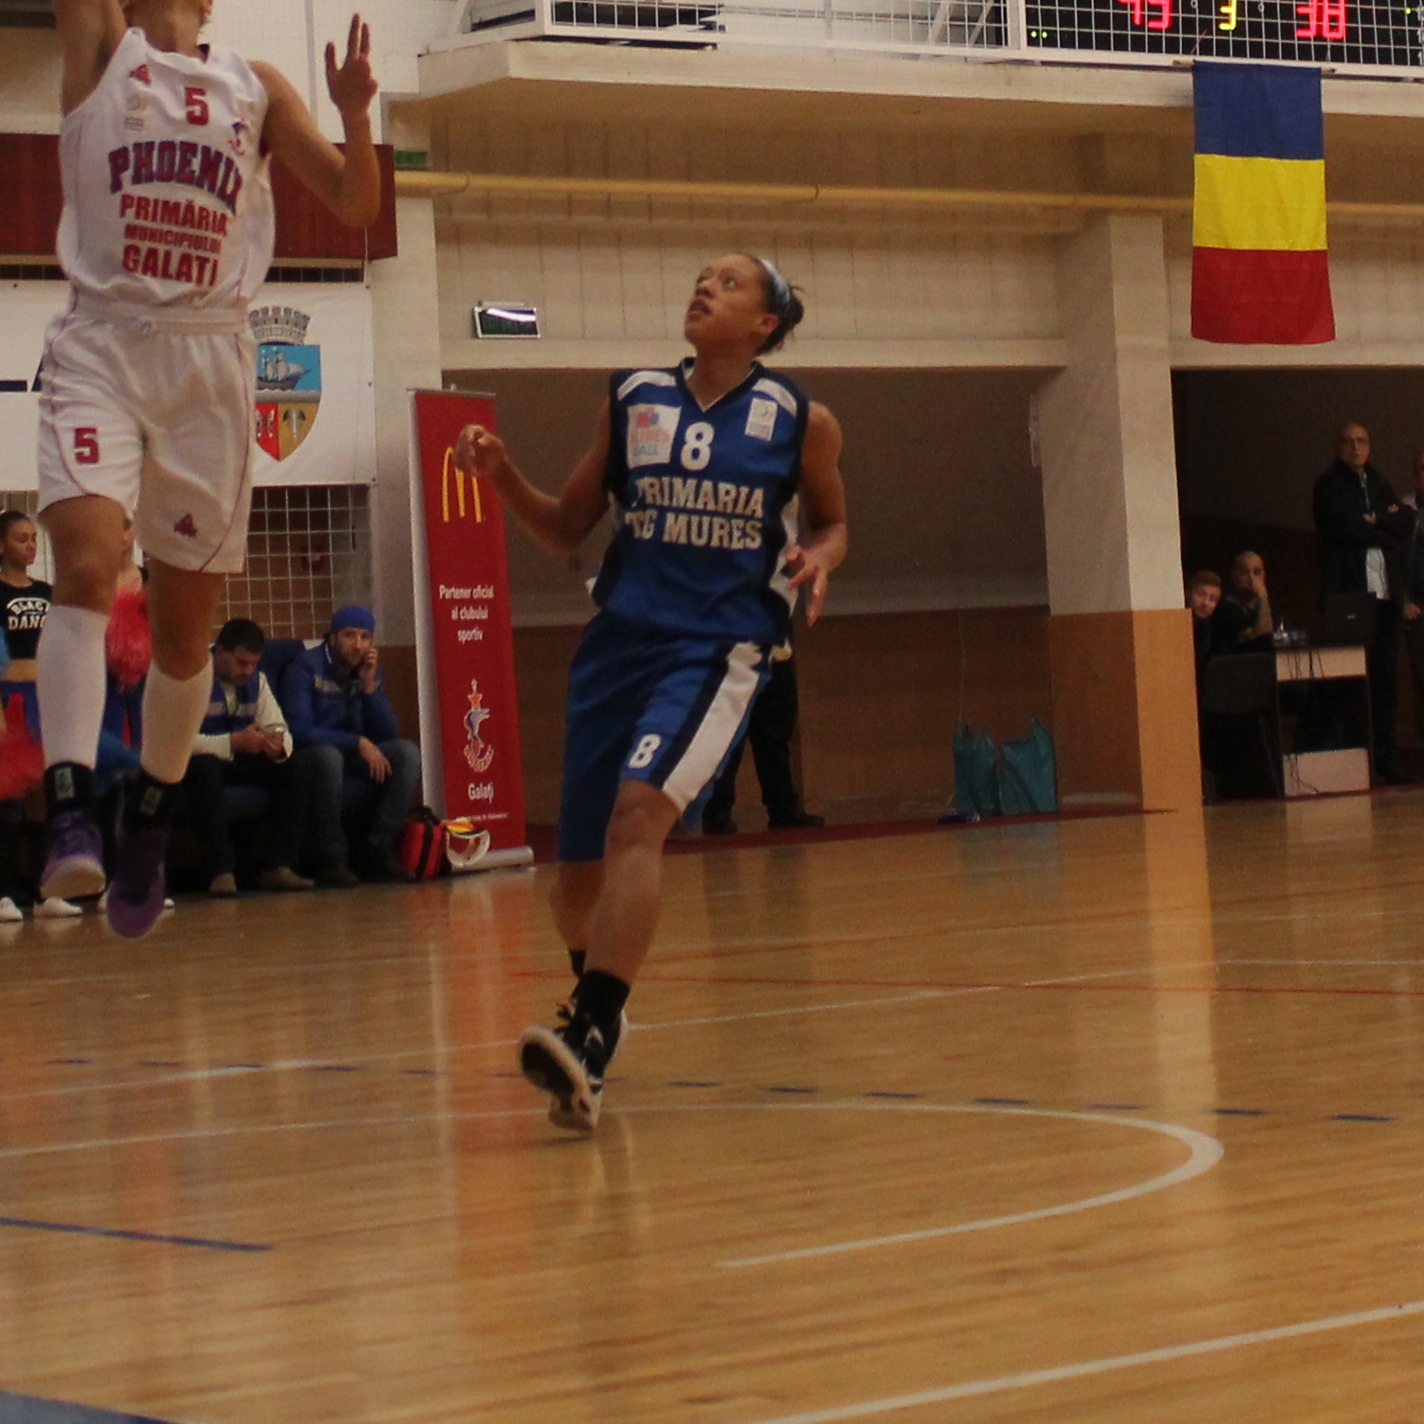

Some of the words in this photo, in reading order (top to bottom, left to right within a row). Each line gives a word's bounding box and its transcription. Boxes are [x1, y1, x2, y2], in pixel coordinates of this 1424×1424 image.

[185, 87, 209, 125] 5
[74, 427, 100, 464] 5
[680, 422, 715, 471] 8
[662, 512, 763, 550] MURES
[628, 733, 662, 770] 8
